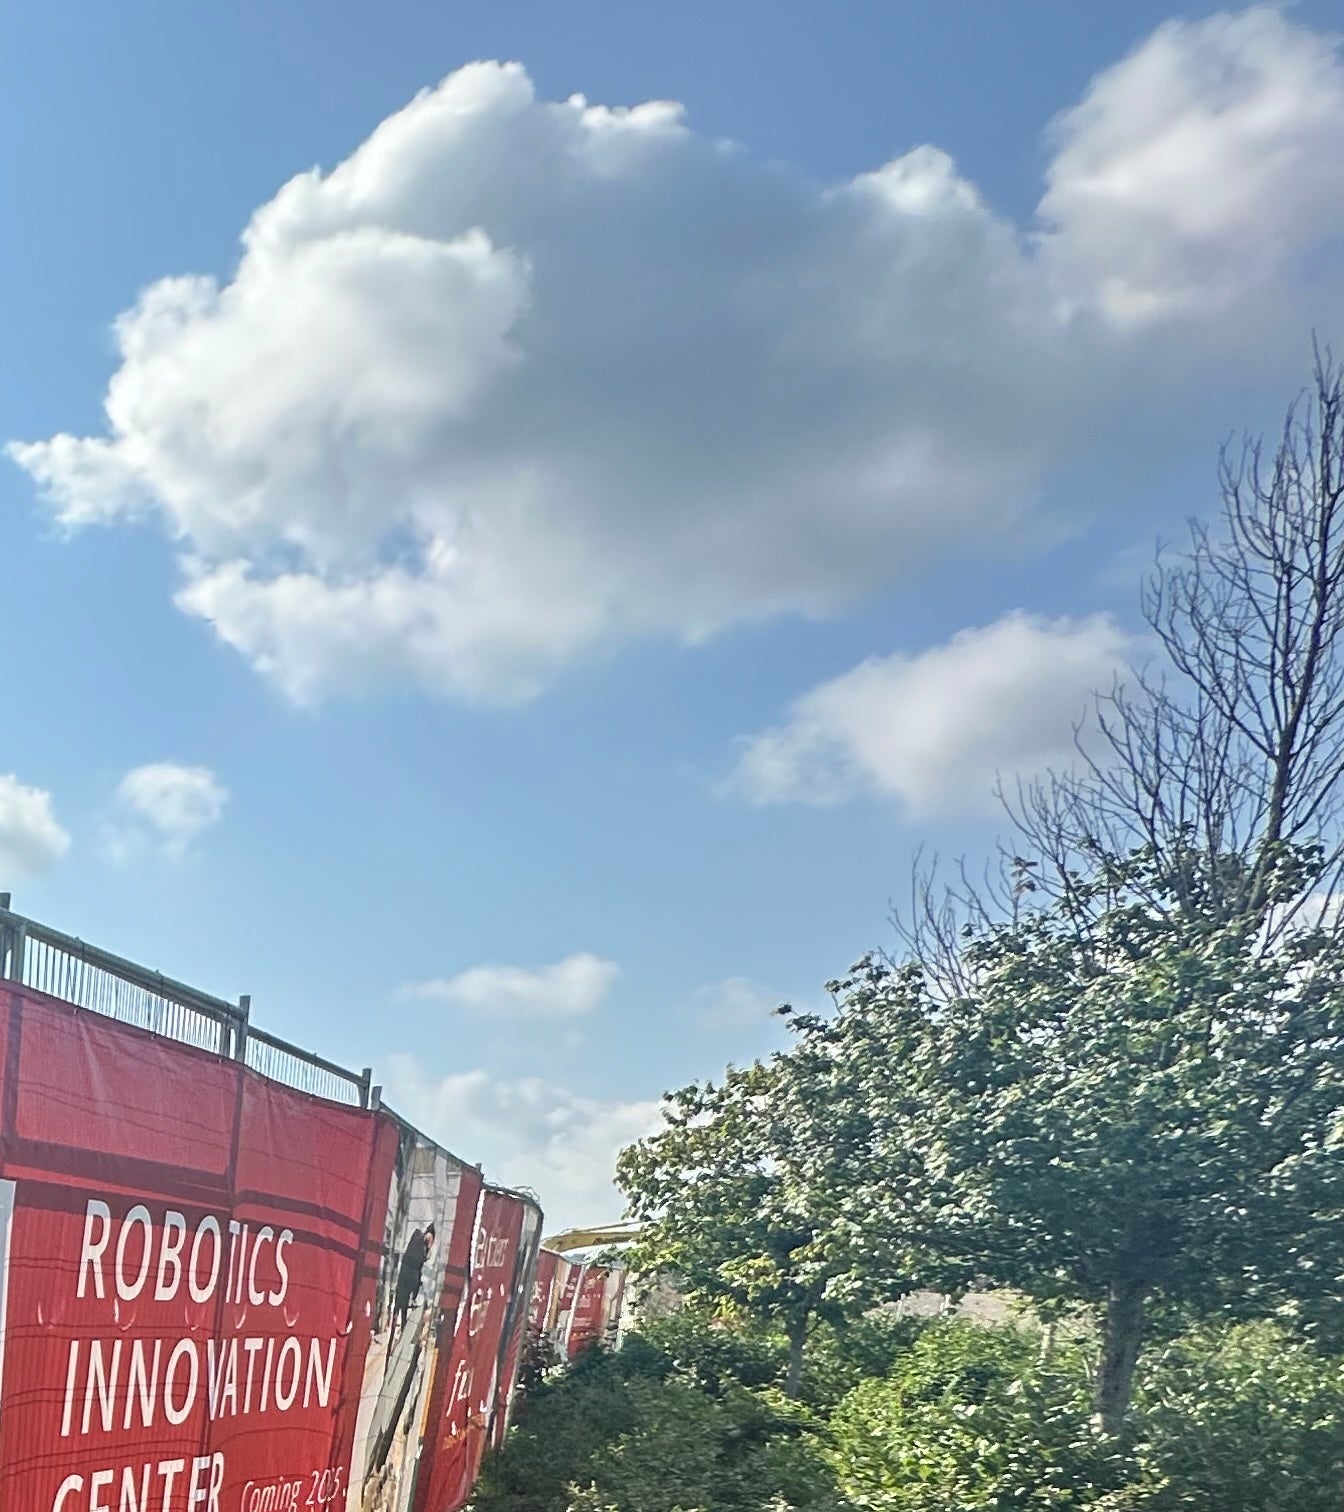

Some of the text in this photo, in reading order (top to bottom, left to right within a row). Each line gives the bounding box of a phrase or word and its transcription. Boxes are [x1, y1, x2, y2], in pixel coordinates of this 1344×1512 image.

[77, 1199, 293, 1306] ROBOTICS
[61, 1337, 336, 1437] INNOVATION
[305, 1466, 343, 1505] 205
